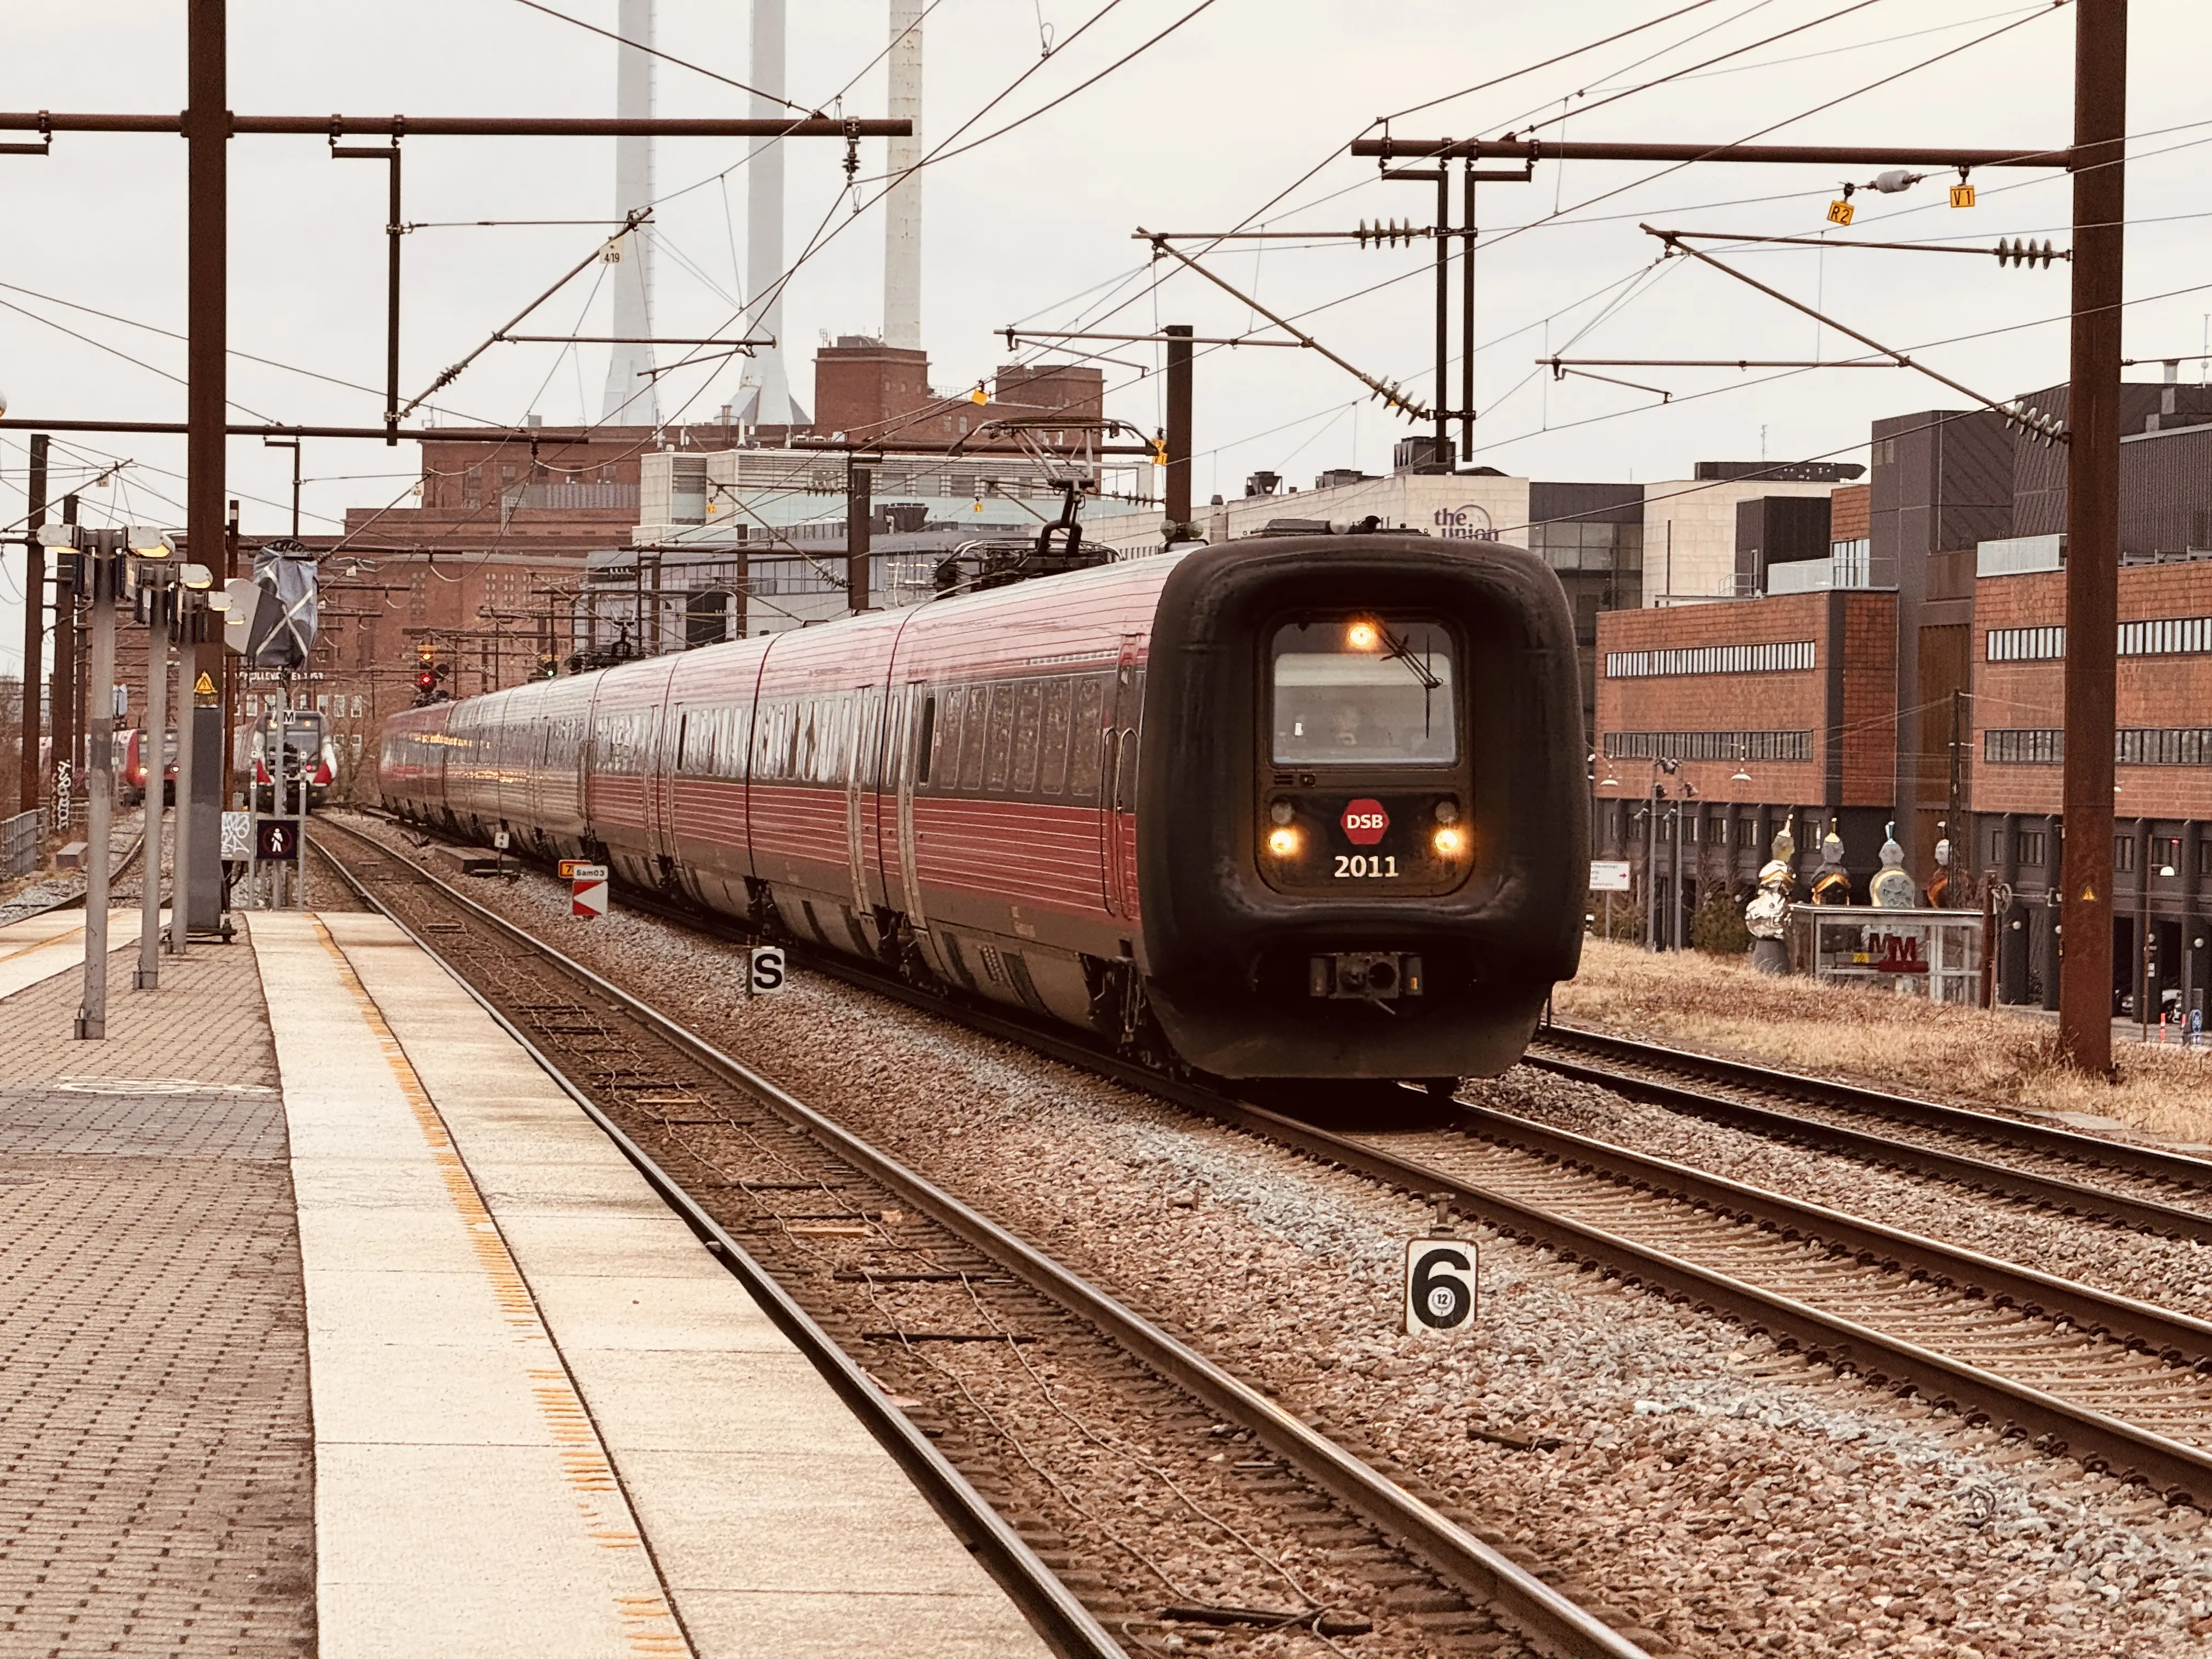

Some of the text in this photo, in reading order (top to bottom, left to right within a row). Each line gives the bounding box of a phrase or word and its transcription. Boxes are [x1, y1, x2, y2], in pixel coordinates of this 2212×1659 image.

[1954, 190, 1971, 206] V1
[1830, 206, 1849, 223] R2
[1434, 507, 1467, 526] the
[1441, 523, 1499, 541] union
[1347, 814, 1384, 829] DSB
[1334, 855, 1399, 877] 2011
[754, 953, 783, 989] S
[1412, 1249, 1471, 1329] 6
[1437, 1294, 1448, 1305] 12
